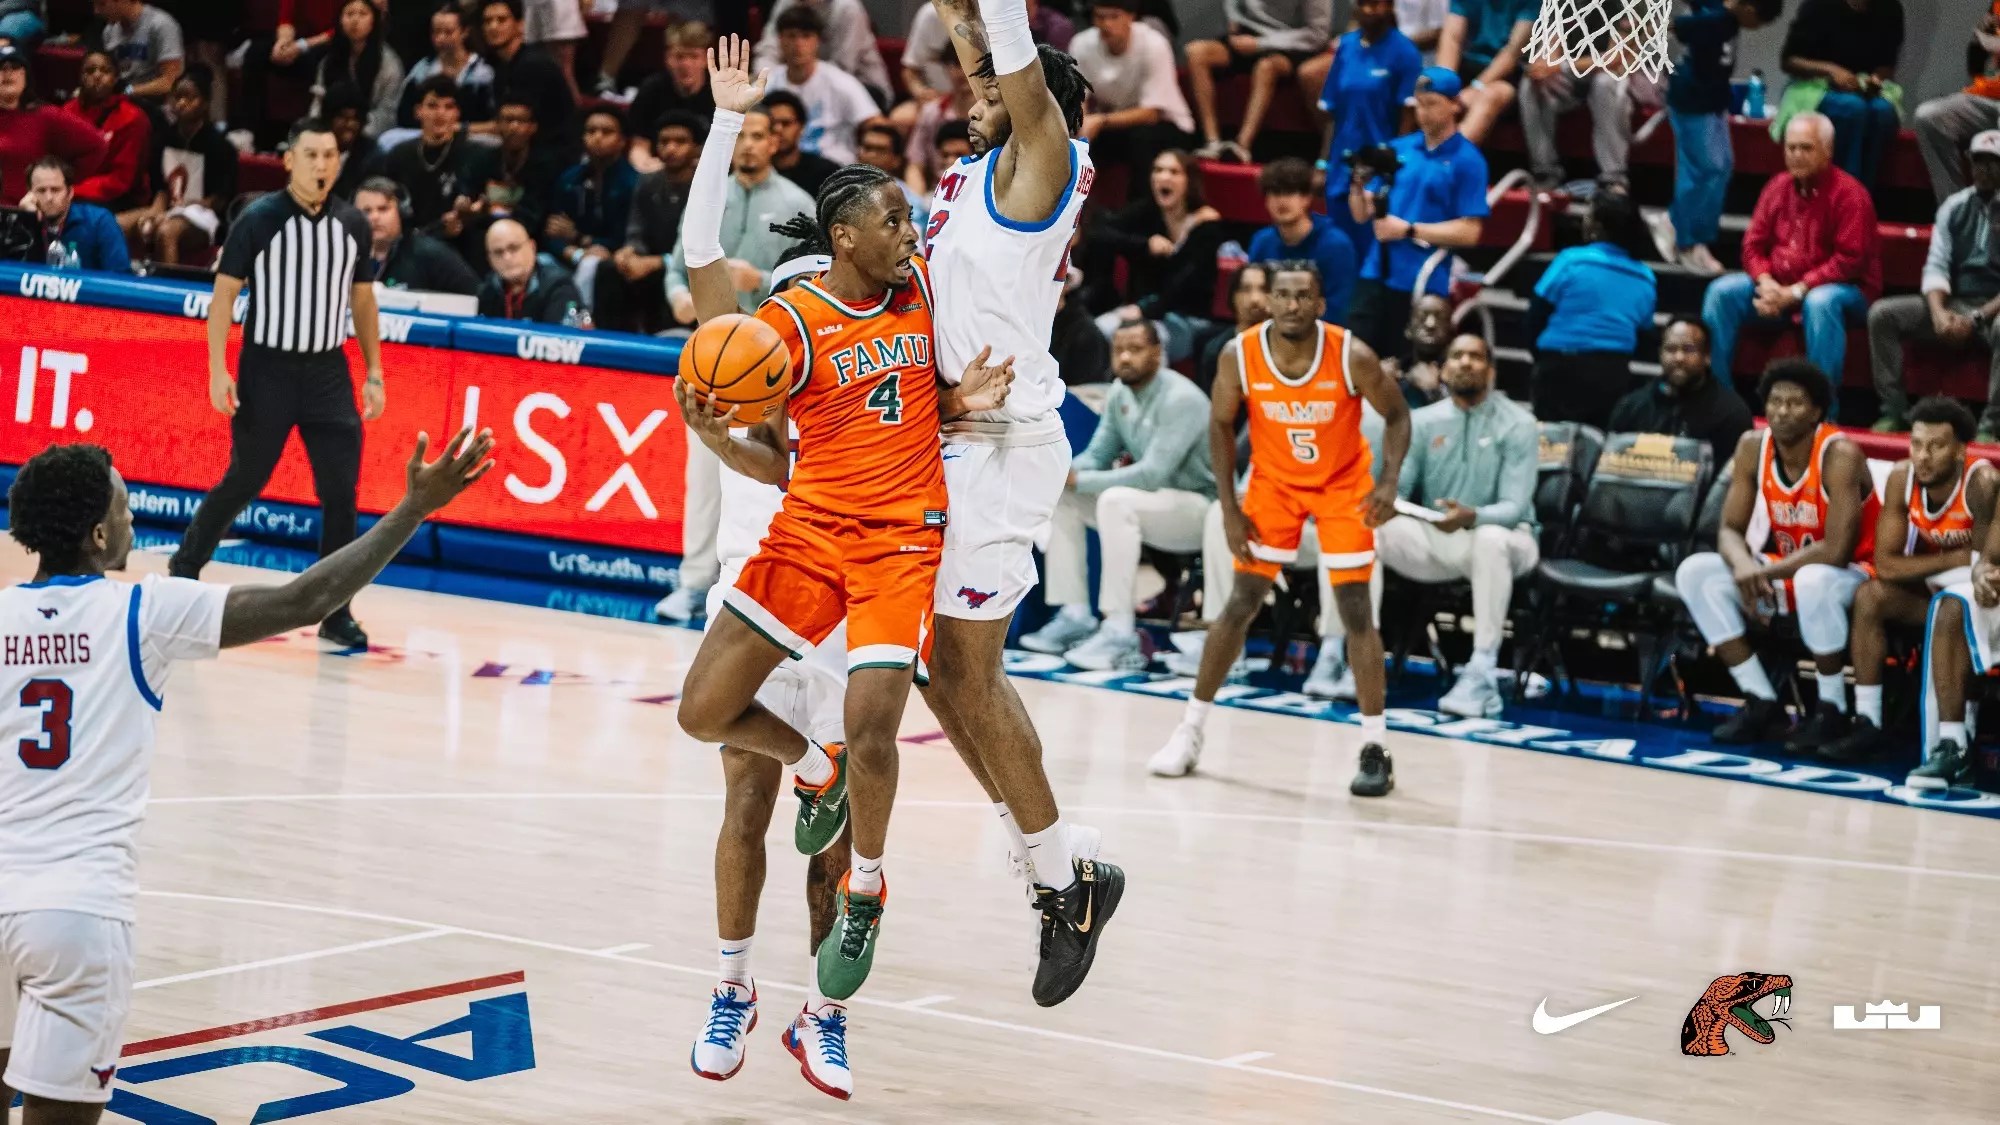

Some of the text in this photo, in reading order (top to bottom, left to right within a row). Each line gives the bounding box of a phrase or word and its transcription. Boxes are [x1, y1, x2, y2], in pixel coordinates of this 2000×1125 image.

[20, 273, 82, 302] UTSW
[517, 335, 586, 364] UTSW
[829, 333, 929, 387] FAMU
[15, 346, 94, 433] IT.
[864, 371, 903, 425] 4
[1287, 429, 1319, 464] 5
[4, 633, 90, 666] HARRIS
[18, 678, 73, 770] 3
